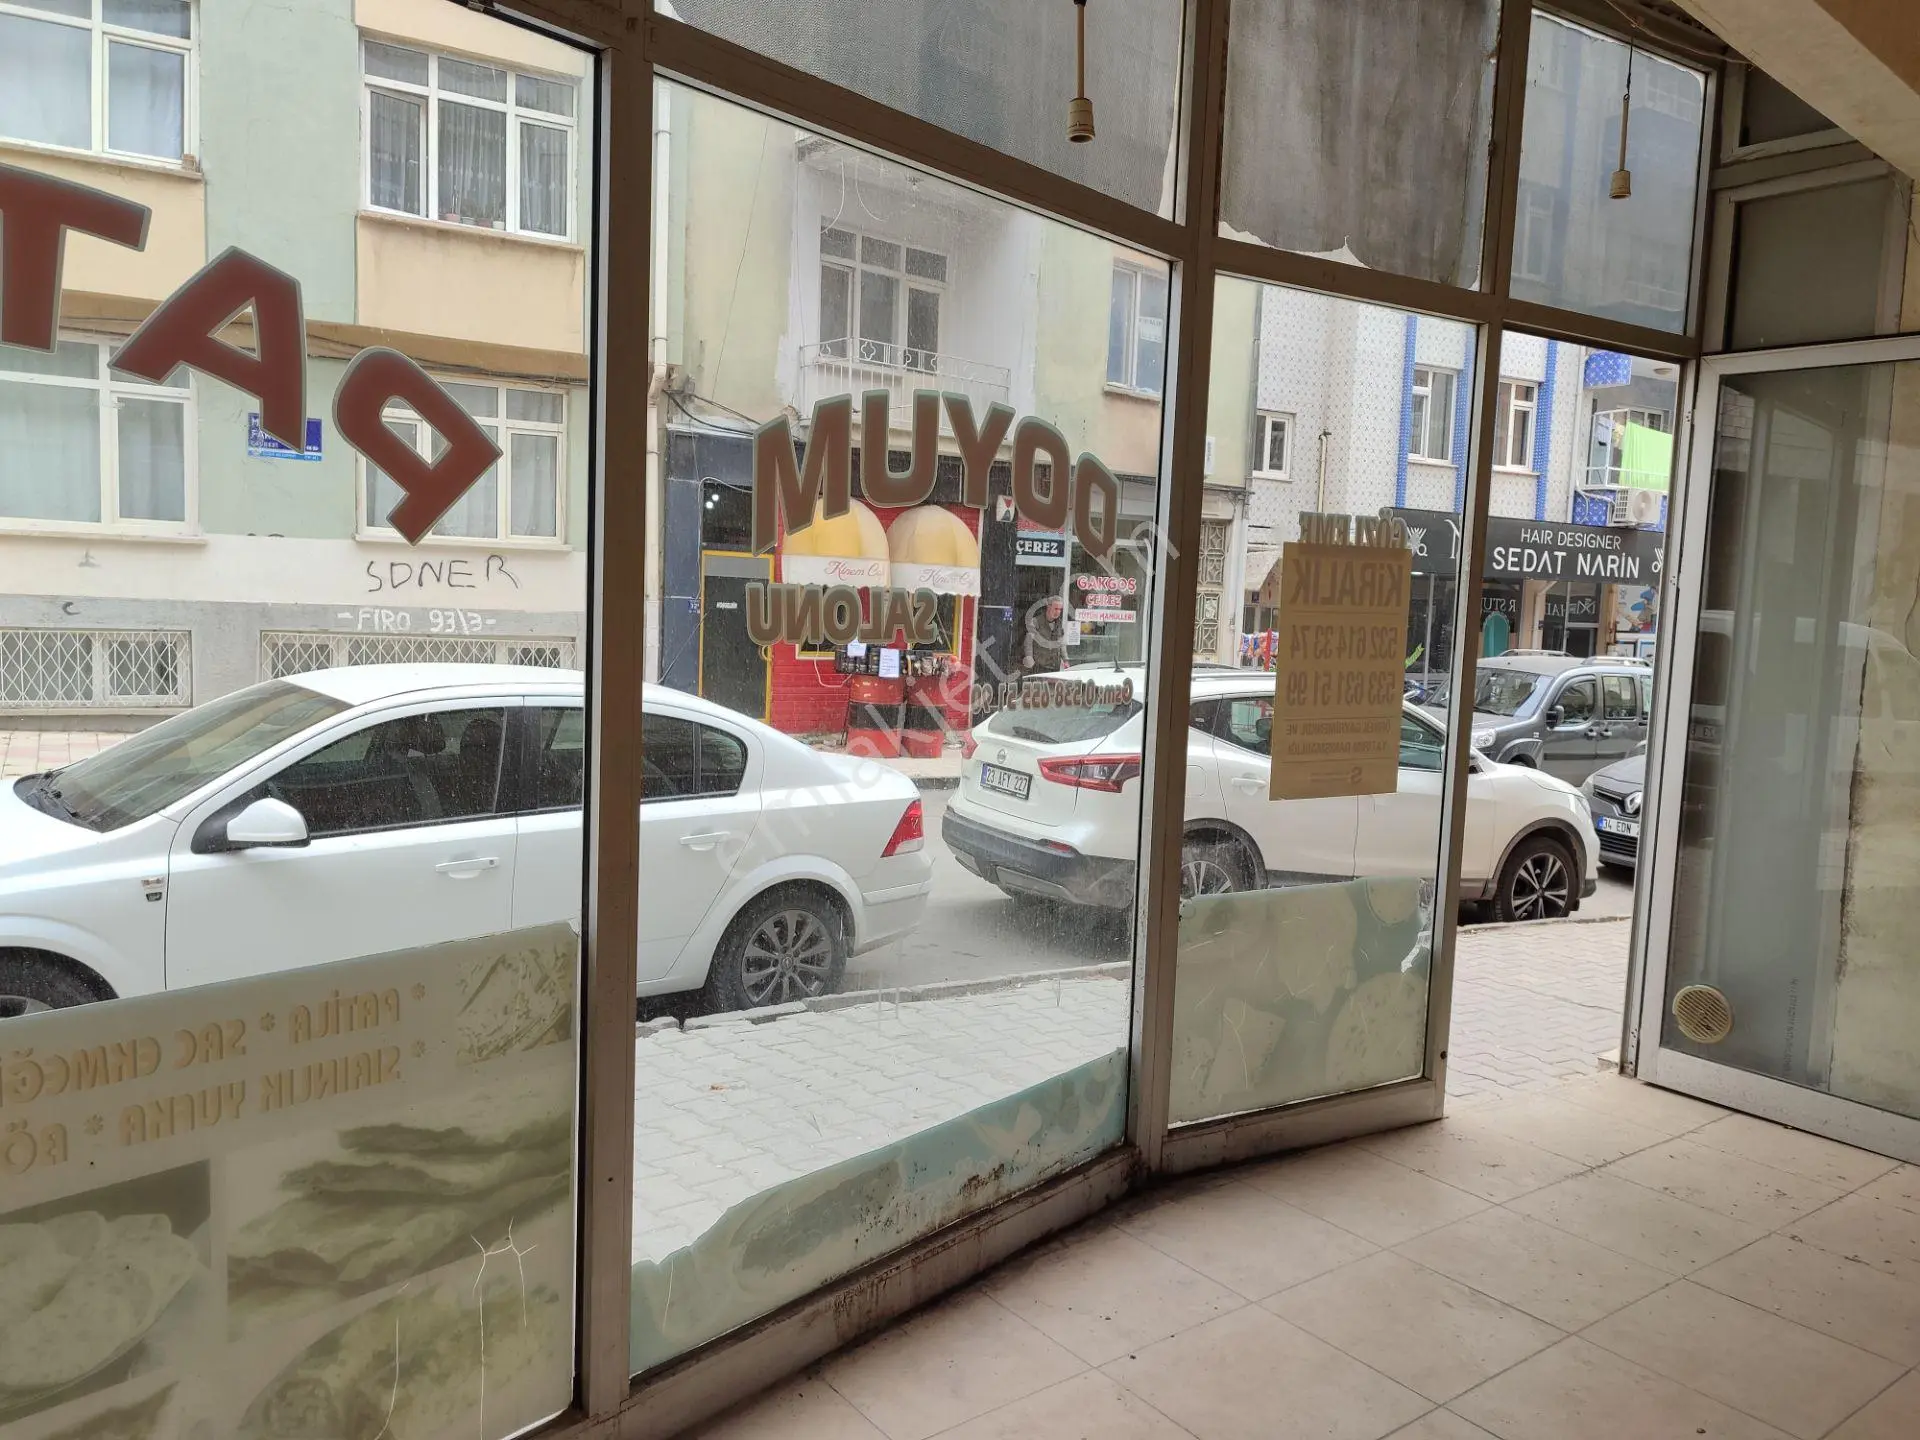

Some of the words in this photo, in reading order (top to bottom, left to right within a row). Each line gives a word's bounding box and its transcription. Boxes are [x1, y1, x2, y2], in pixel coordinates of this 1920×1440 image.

[1015, 540, 1058, 555] ÇEREZ
[1520, 528, 1553, 545] HAIR
[1557, 531, 1622, 550] DESIGNER
[1492, 546, 1567, 575] SEDAT
[1576, 552, 1640, 579] NARİN
